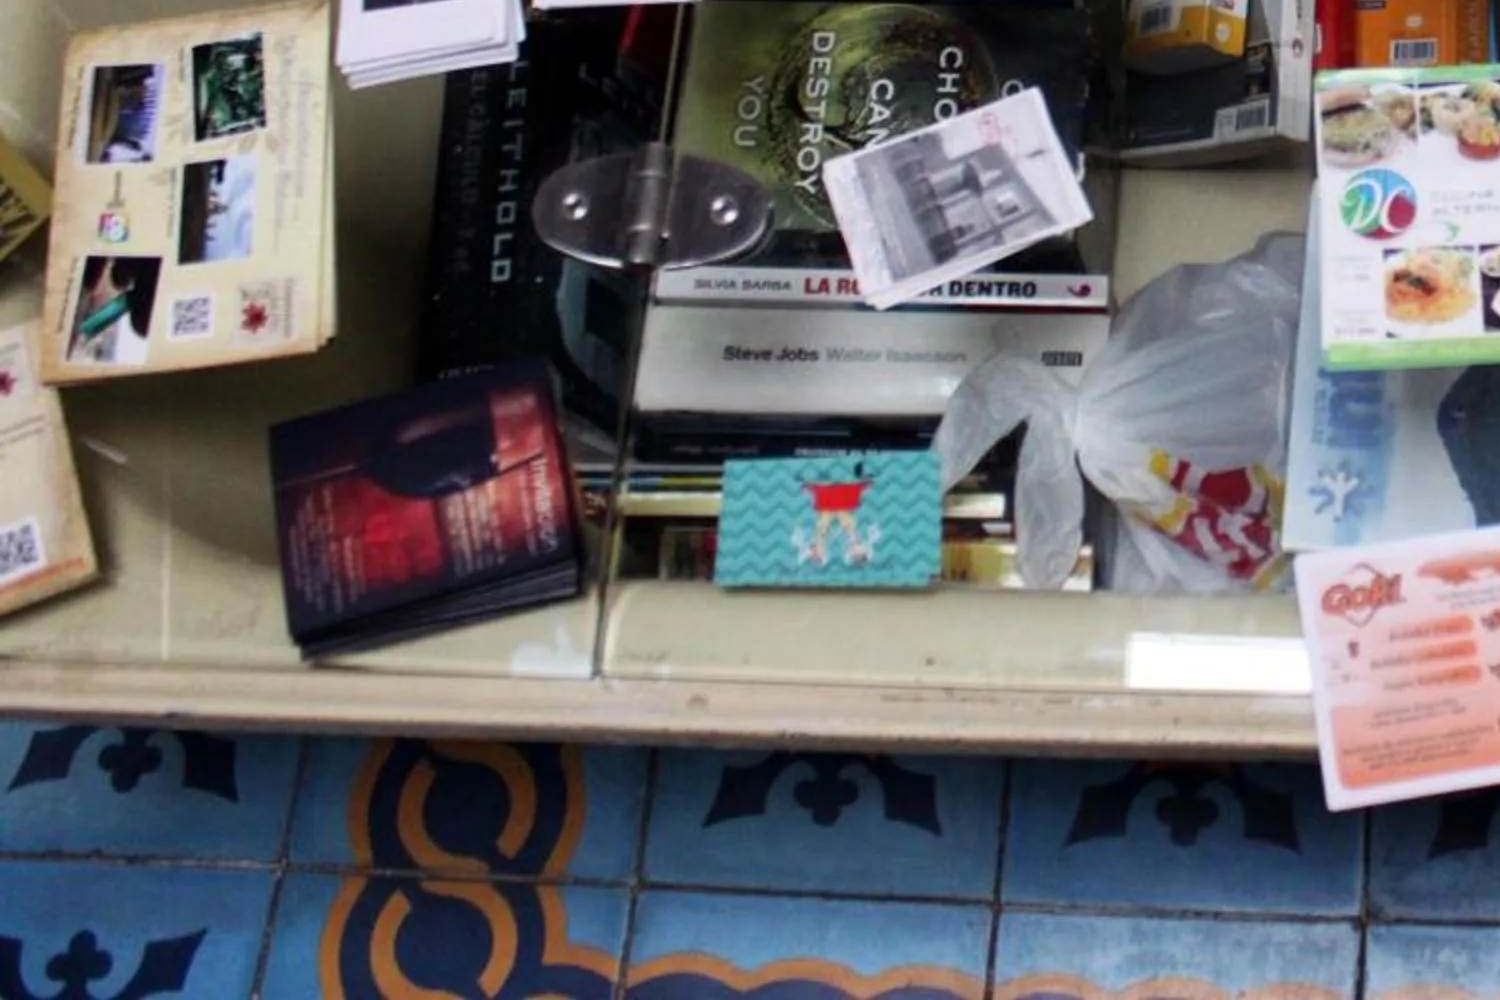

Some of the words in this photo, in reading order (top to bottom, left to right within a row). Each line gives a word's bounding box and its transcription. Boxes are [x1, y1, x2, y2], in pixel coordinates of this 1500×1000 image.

[731, 74, 765, 151] YOU
[796, 30, 836, 199] DESTROY
[866, 77, 896, 149] CAN
[490, 60, 529, 281] LEITHOLD
[694, 278, 737, 291] SILVIA
[803, 277, 830, 295] LA
[948, 280, 1038, 298] DENTRO
[722, 345, 771, 363] Steve
[774, 344, 819, 363] Jobs
[825, 346, 883, 363] Walter
